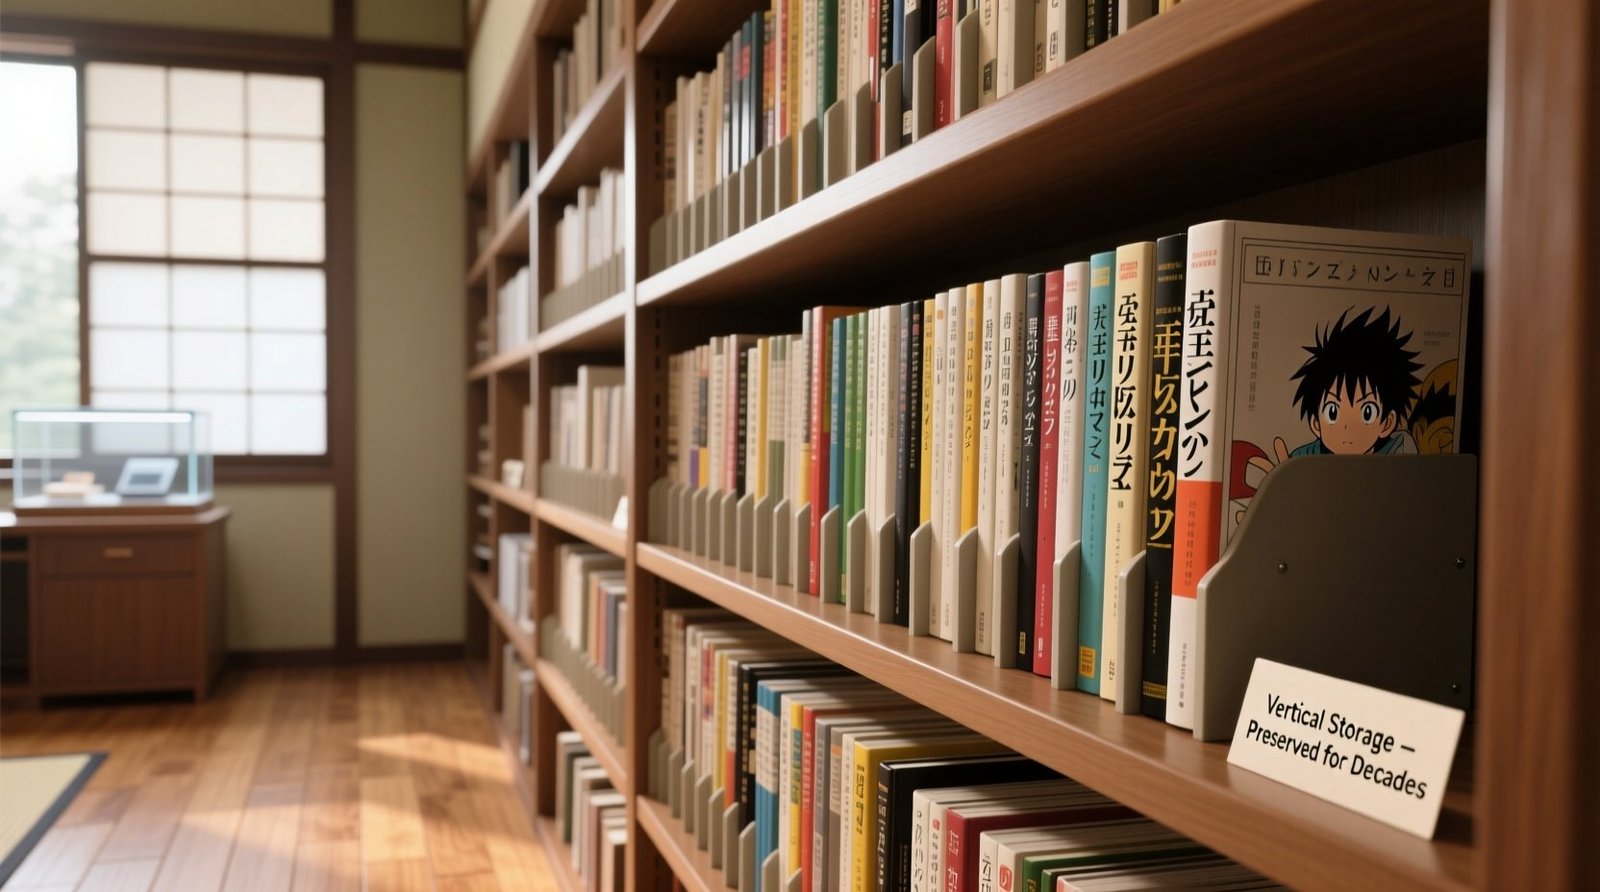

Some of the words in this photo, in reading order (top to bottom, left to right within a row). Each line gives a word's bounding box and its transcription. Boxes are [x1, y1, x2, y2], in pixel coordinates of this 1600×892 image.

[1267, 693, 1326, 730] Vertical
[1327, 713, 1395, 754] Storage
[1246, 719, 1322, 762] Preserved
[1322, 744, 1349, 770] for
[1350, 755, 1428, 799] Decades
